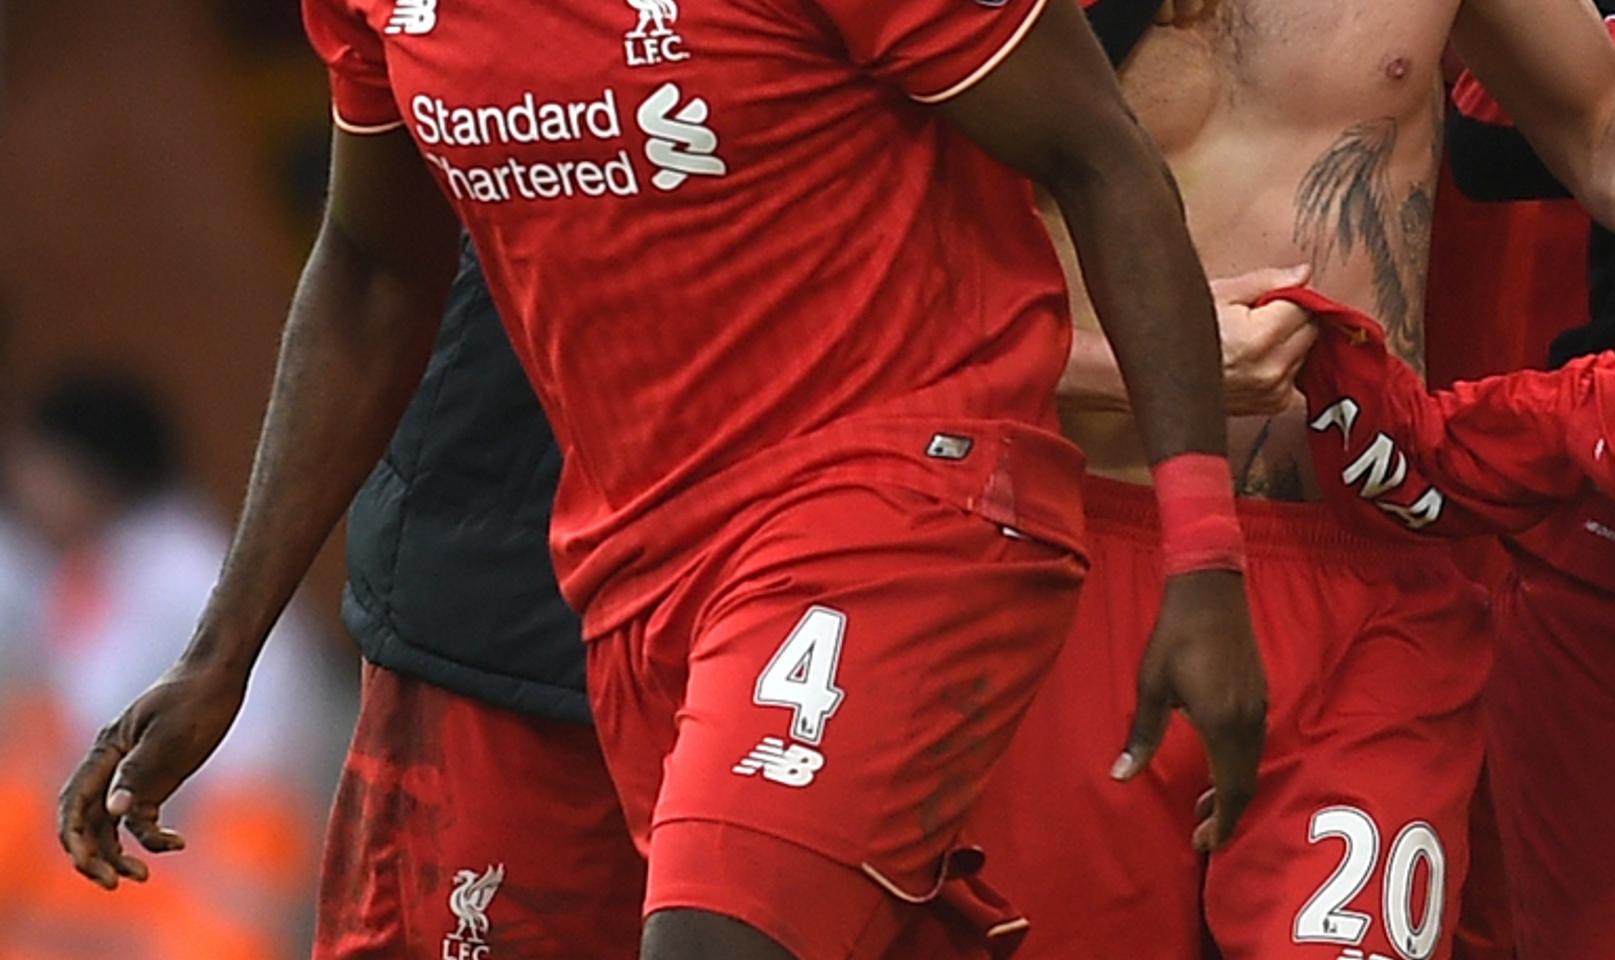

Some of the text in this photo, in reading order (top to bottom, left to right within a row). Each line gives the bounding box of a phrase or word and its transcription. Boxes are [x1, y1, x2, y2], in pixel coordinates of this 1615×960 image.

[412, 88, 621, 145] Standard
[427, 150, 639, 202] hartered
[753, 604, 848, 746] 4
[1292, 804, 1446, 960] 20
